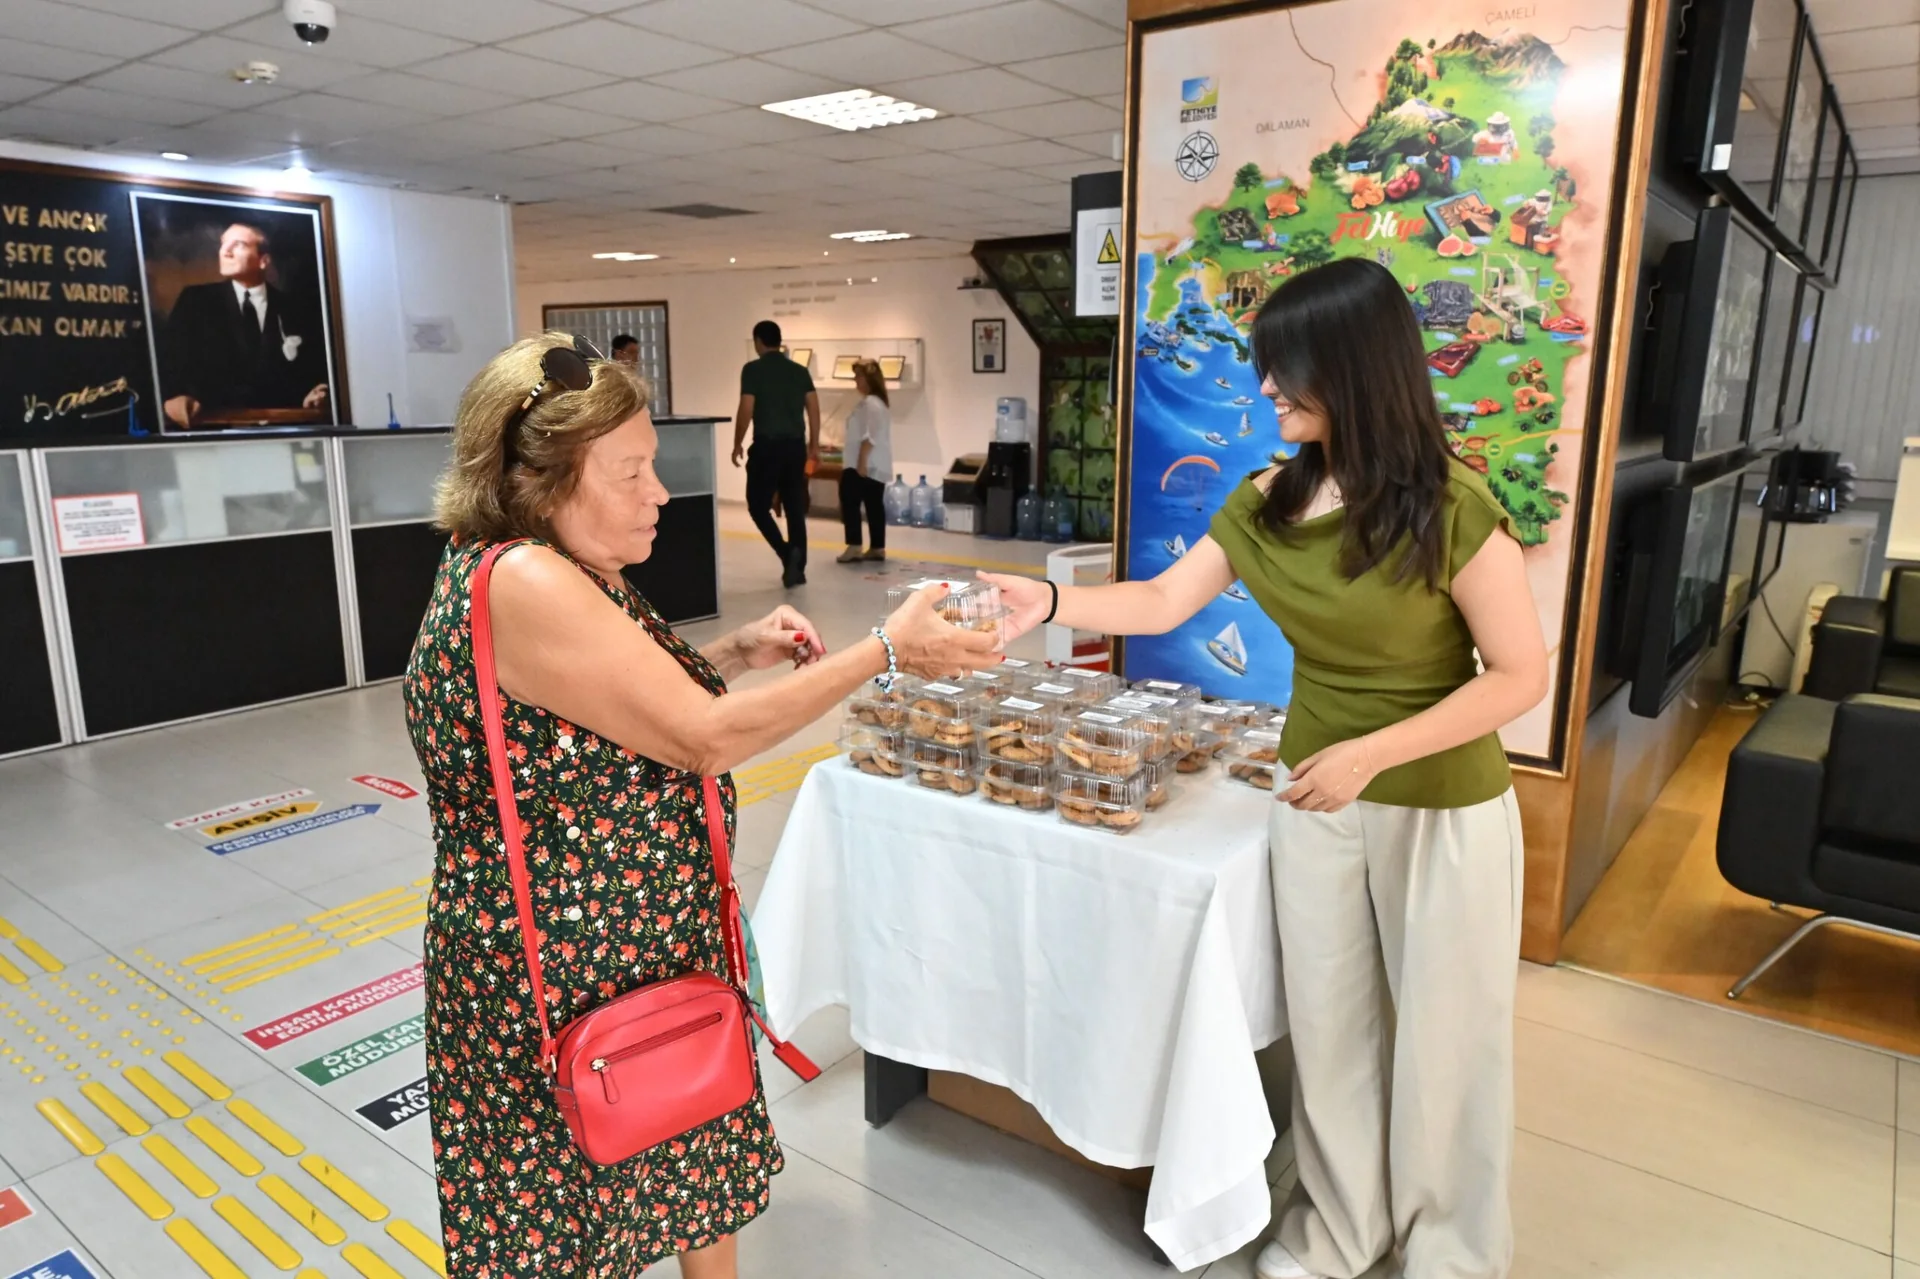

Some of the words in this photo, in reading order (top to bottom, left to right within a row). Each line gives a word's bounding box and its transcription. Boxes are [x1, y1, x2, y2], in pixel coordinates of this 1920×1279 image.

[1255, 118, 1311, 134] DALAMAN
[2, 205, 29, 226] VE
[38, 208, 108, 232] ANCAK
[5, 241, 53, 268] ŞEYE
[64, 246, 107, 272] ÇOK
[174, 807, 242, 827] EVRAK
[322, 966, 425, 1012] KAYNAKLAR
[322, 1039, 387, 1067] ÖZEL
[382, 1018, 427, 1042] KAL
[389, 1095, 431, 1122] MÜ
